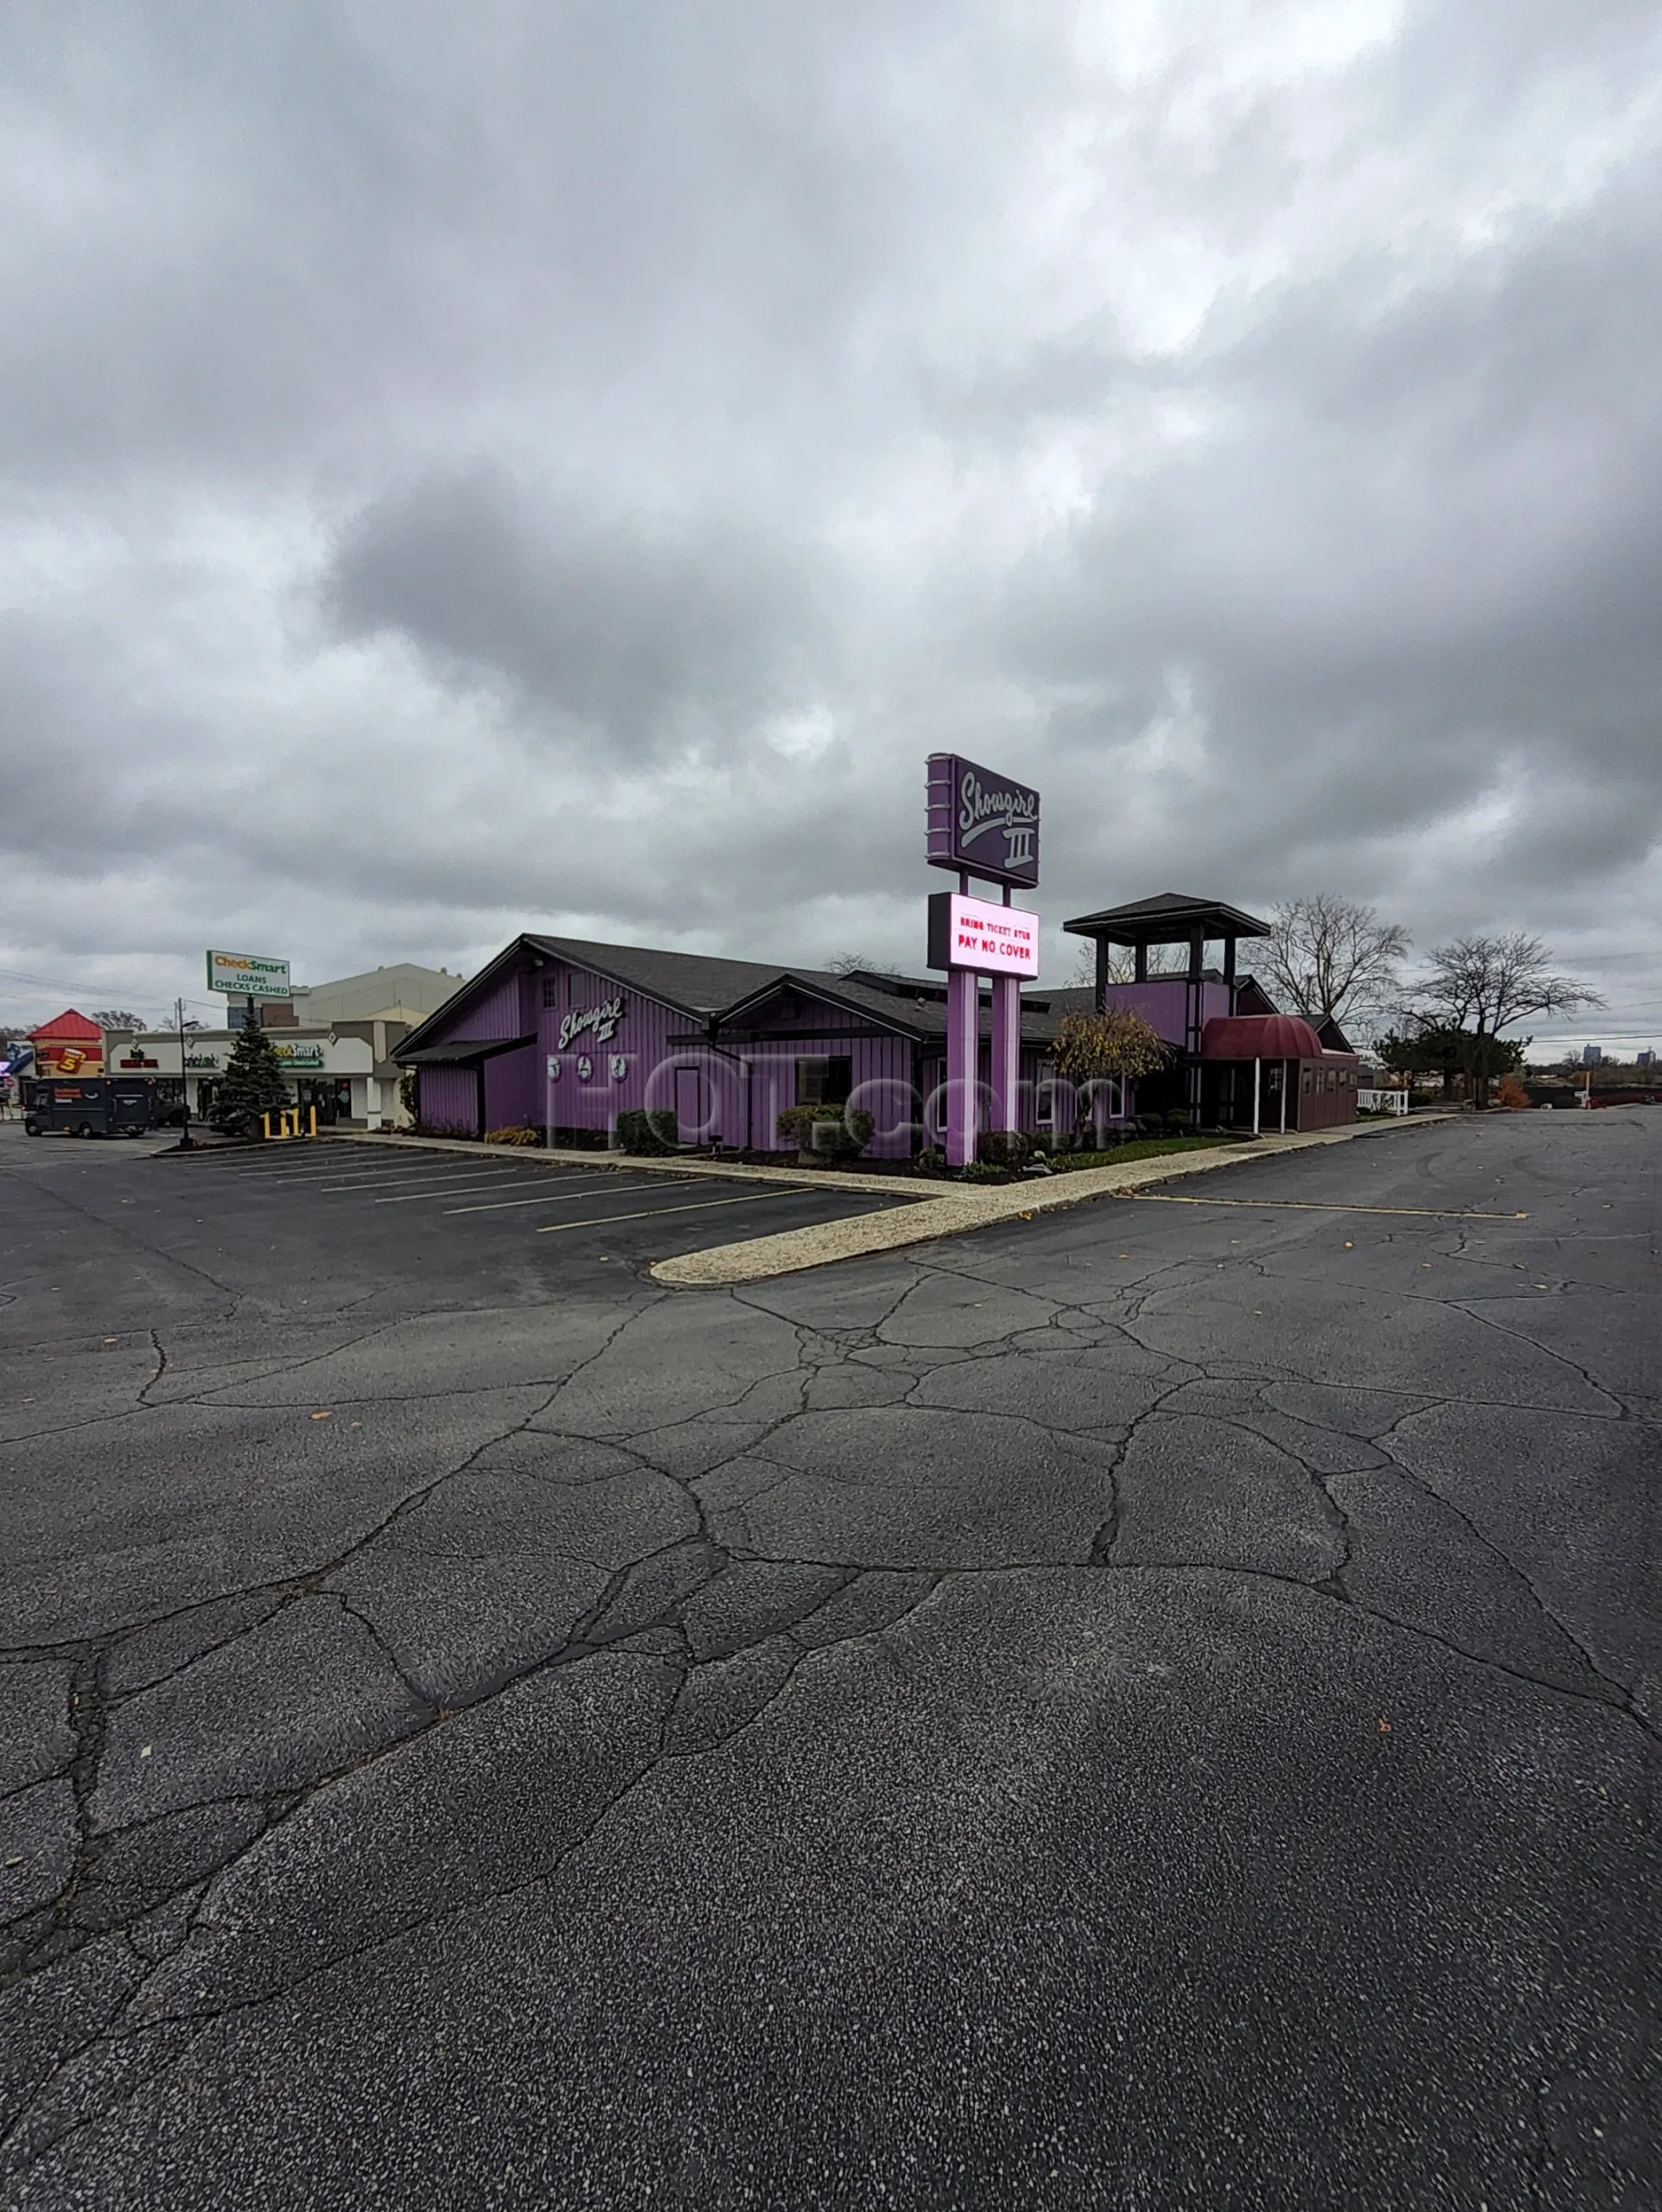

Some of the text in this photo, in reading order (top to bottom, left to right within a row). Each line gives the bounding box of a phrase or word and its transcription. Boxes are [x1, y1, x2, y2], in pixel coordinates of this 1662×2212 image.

[958, 772, 1038, 830] Showgirl
[1002, 827, 1035, 869] III
[960, 916, 984, 931] BRING
[986, 922, 1011, 938] TICKET
[958, 934, 1030, 960] PAY NO COVER
[214, 956, 287, 974] CheckSmart
[214, 980, 288, 995] CHECKS CASHED
[236, 973, 267, 984] LOANS
[557, 996, 623, 1050] Showgirl
[596, 1019, 614, 1044] III
